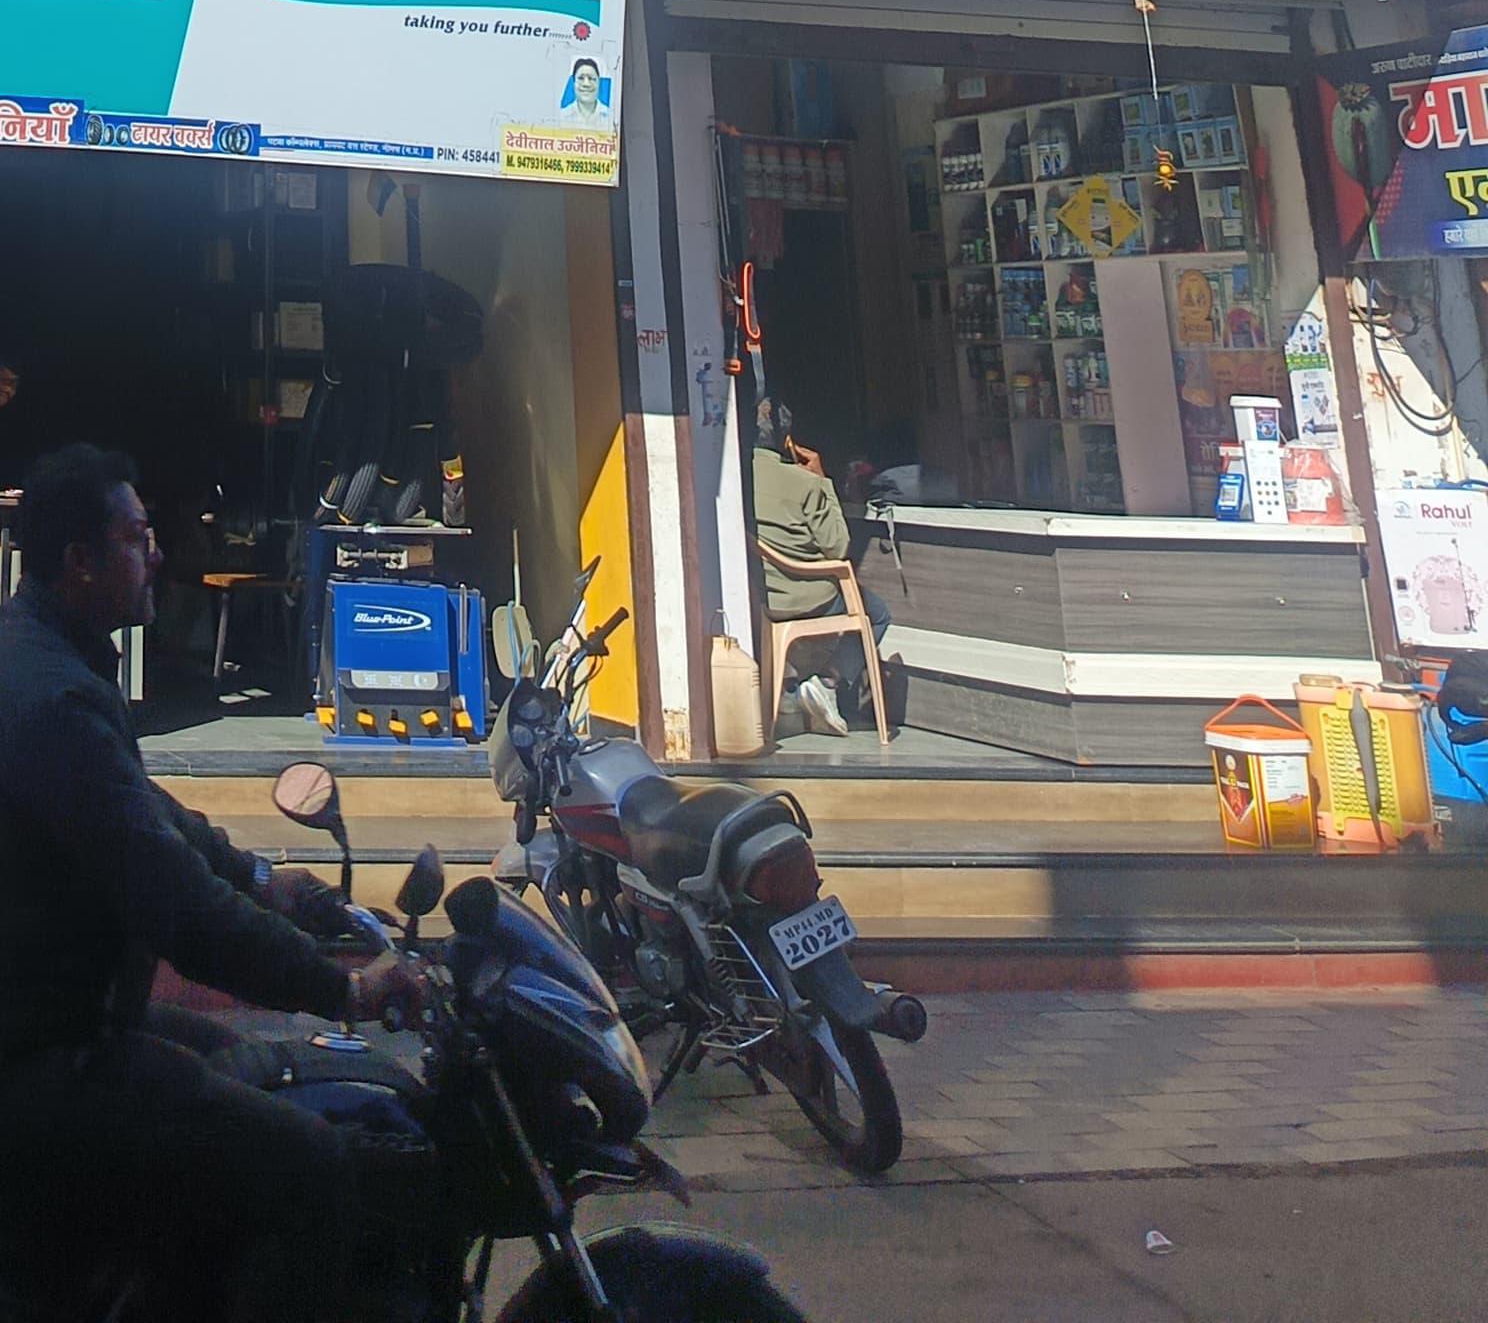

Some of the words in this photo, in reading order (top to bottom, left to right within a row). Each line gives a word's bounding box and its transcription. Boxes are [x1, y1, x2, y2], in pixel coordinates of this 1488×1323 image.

[403, 13, 456, 35] taking
[459, 19, 489, 36] you
[132, 121, 173, 147] टायर
[173, 119, 214, 149] वर्क्स
[506, 131, 554, 152] देवीलाल
[437, 146, 459, 161] PIN:
[462, 148, 500, 164] 458441
[506, 156, 517, 169] M.
[566, 159, 611, 176] 7999339414
[1420, 502, 1472, 521] Rahul
[785, 915, 850, 965] 2027
